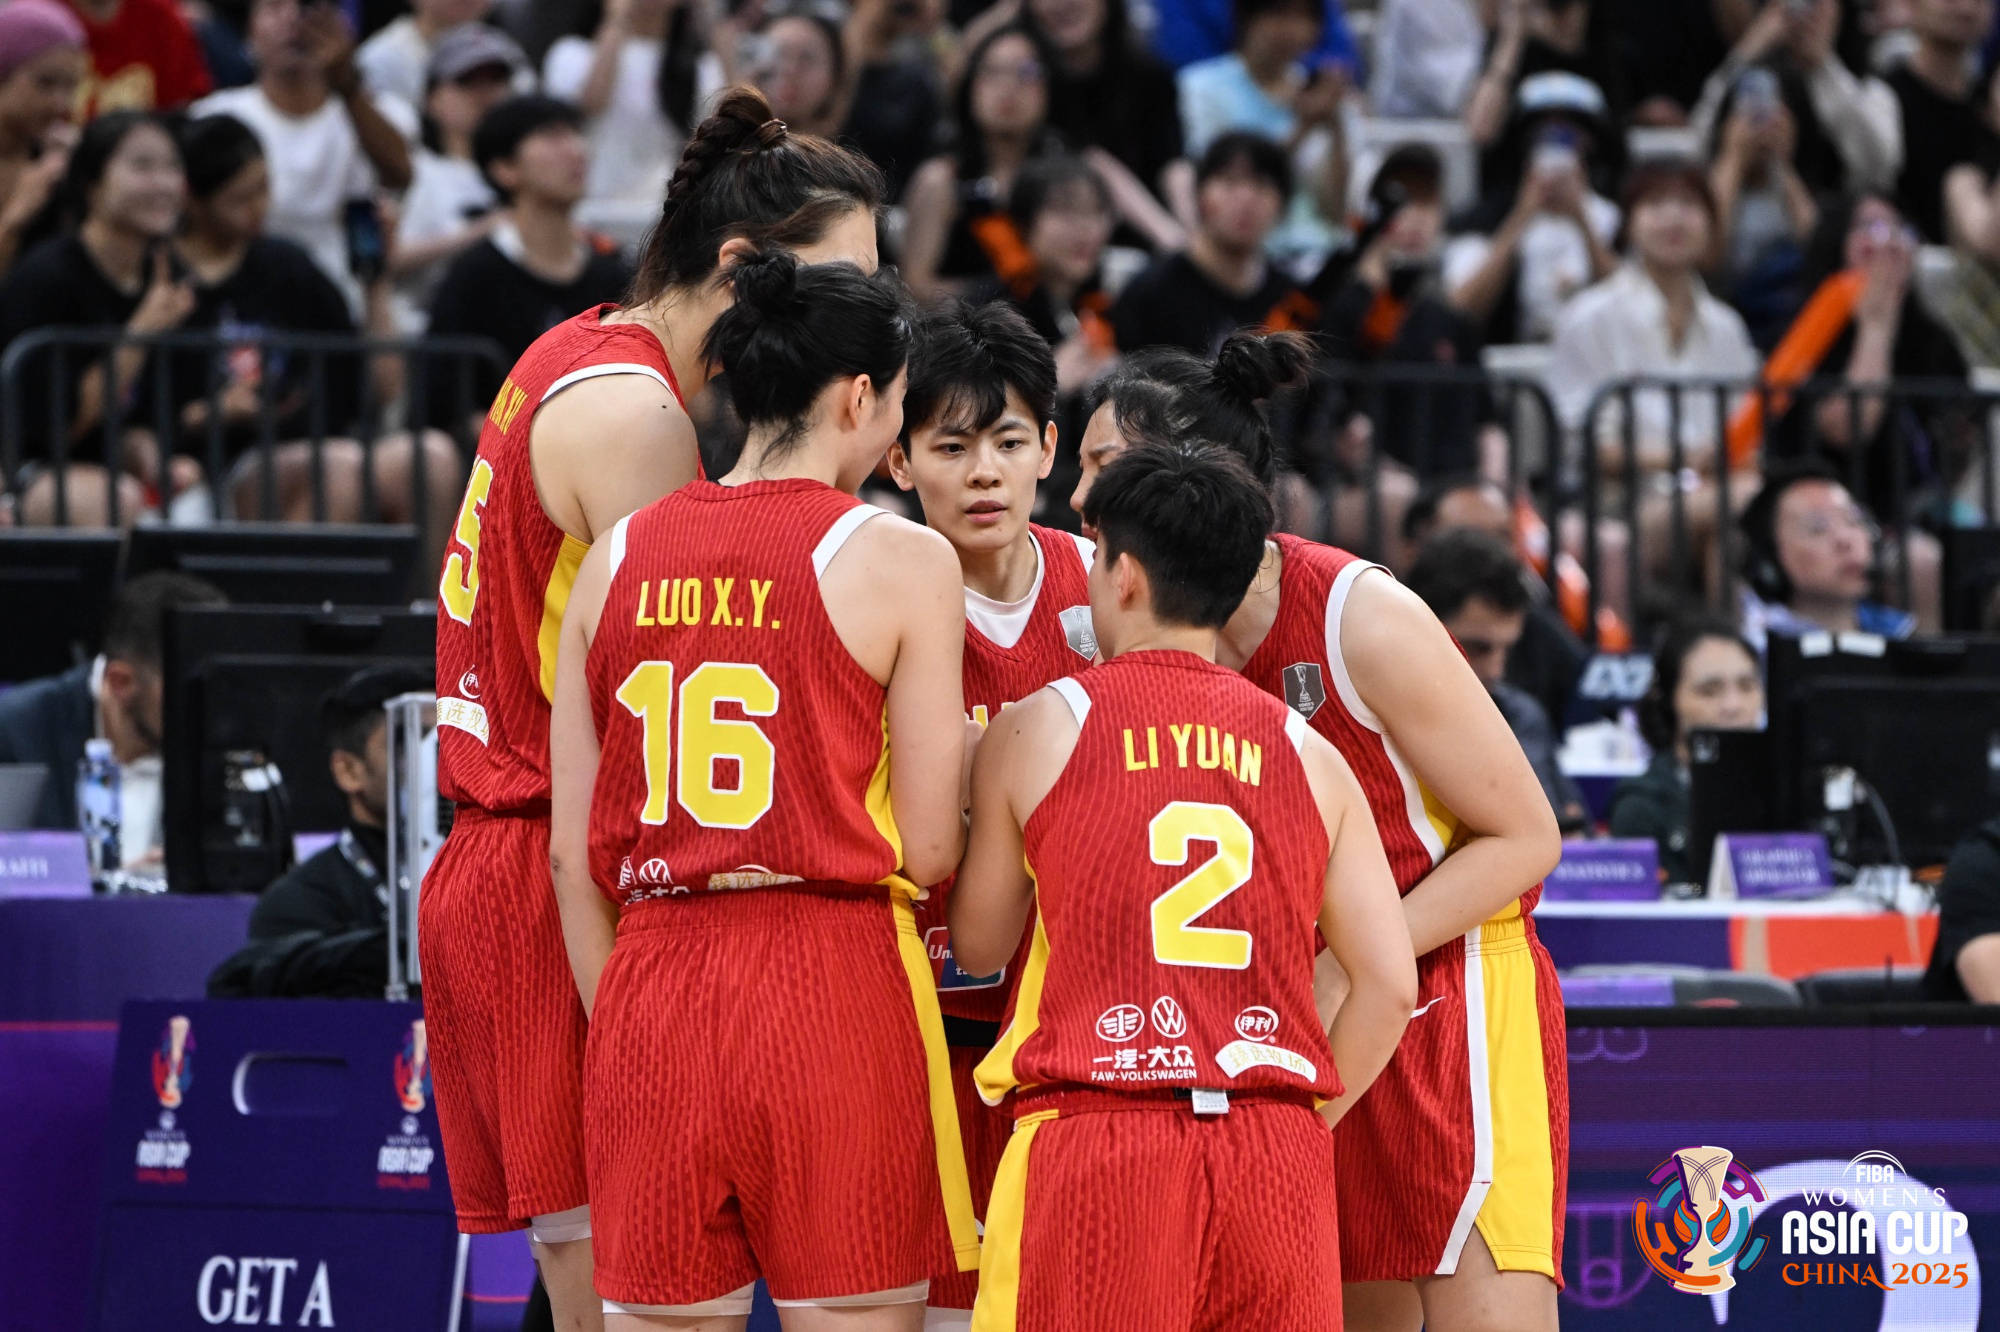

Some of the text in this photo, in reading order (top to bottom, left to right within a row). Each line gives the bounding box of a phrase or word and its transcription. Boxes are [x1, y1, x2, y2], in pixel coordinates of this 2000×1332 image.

[636, 578, 780, 629] LUO X.Y.
[616, 661, 780, 830] 16
[1123, 723, 1262, 786] LI YUAN
[1149, 801, 1254, 970] 2
[1239, 1015, 1271, 1033] 伊利
[1091, 1068, 1197, 1082] FAW-VOLKSWAGEN
[1093, 1046, 1195, 1069] 一汽-大众
[197, 1255, 335, 1328] GET A
